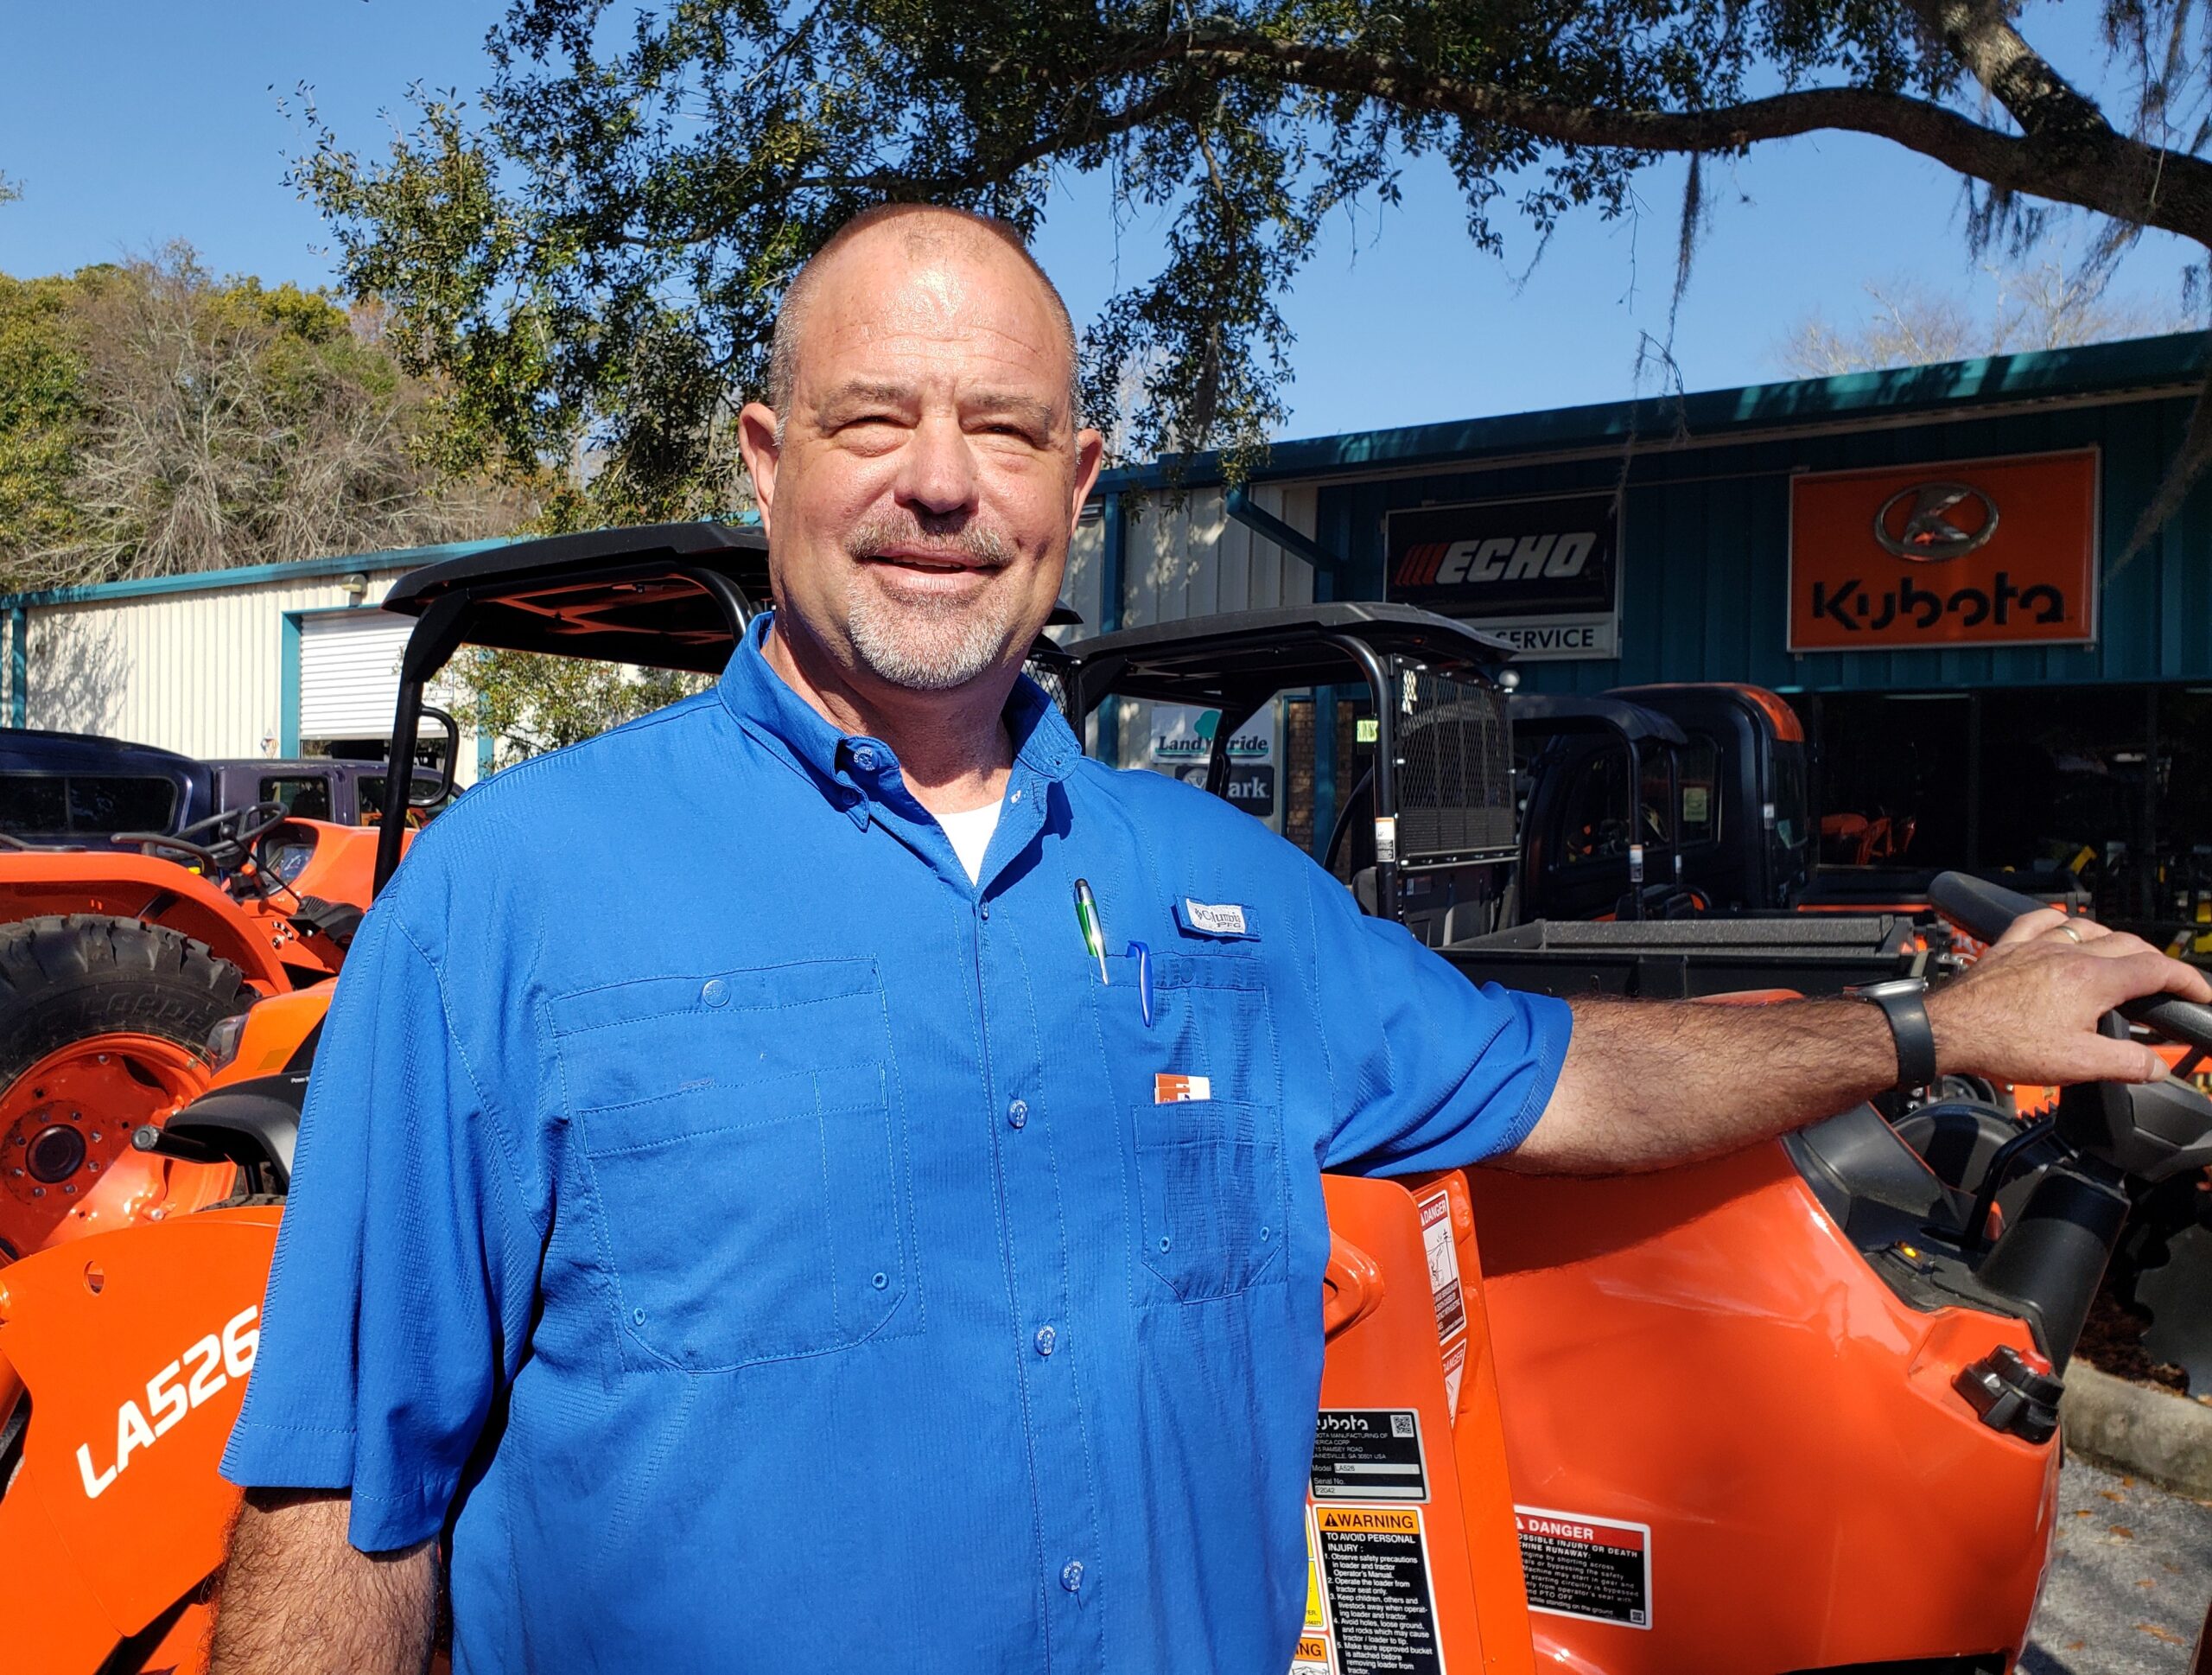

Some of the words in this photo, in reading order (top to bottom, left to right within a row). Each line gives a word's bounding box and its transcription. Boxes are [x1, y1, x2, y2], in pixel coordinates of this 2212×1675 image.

[1435, 532, 1597, 584] ECHO
[1813, 571, 2065, 630] Kubota
[1158, 736, 1202, 750] Land
[1229, 736, 1268, 750] ride
[1423, 1200, 1446, 1224] DANGER
[76, 1304, 260, 1499] LA526
[1316, 1415, 1369, 1430] ubota
[1338, 1513, 1414, 1528] WARNING
[1529, 1519, 1593, 1540] DANGER
[1368, 1534, 1415, 1544] PERSONAL
[1517, 1533, 1554, 1545] OSSIBLE
[1557, 1540, 1589, 1551] INJURY
[1607, 1547, 1637, 1557] DEATH
[1547, 1562, 1585, 1575] bypassing
[1557, 1557, 1587, 1568] shorting
